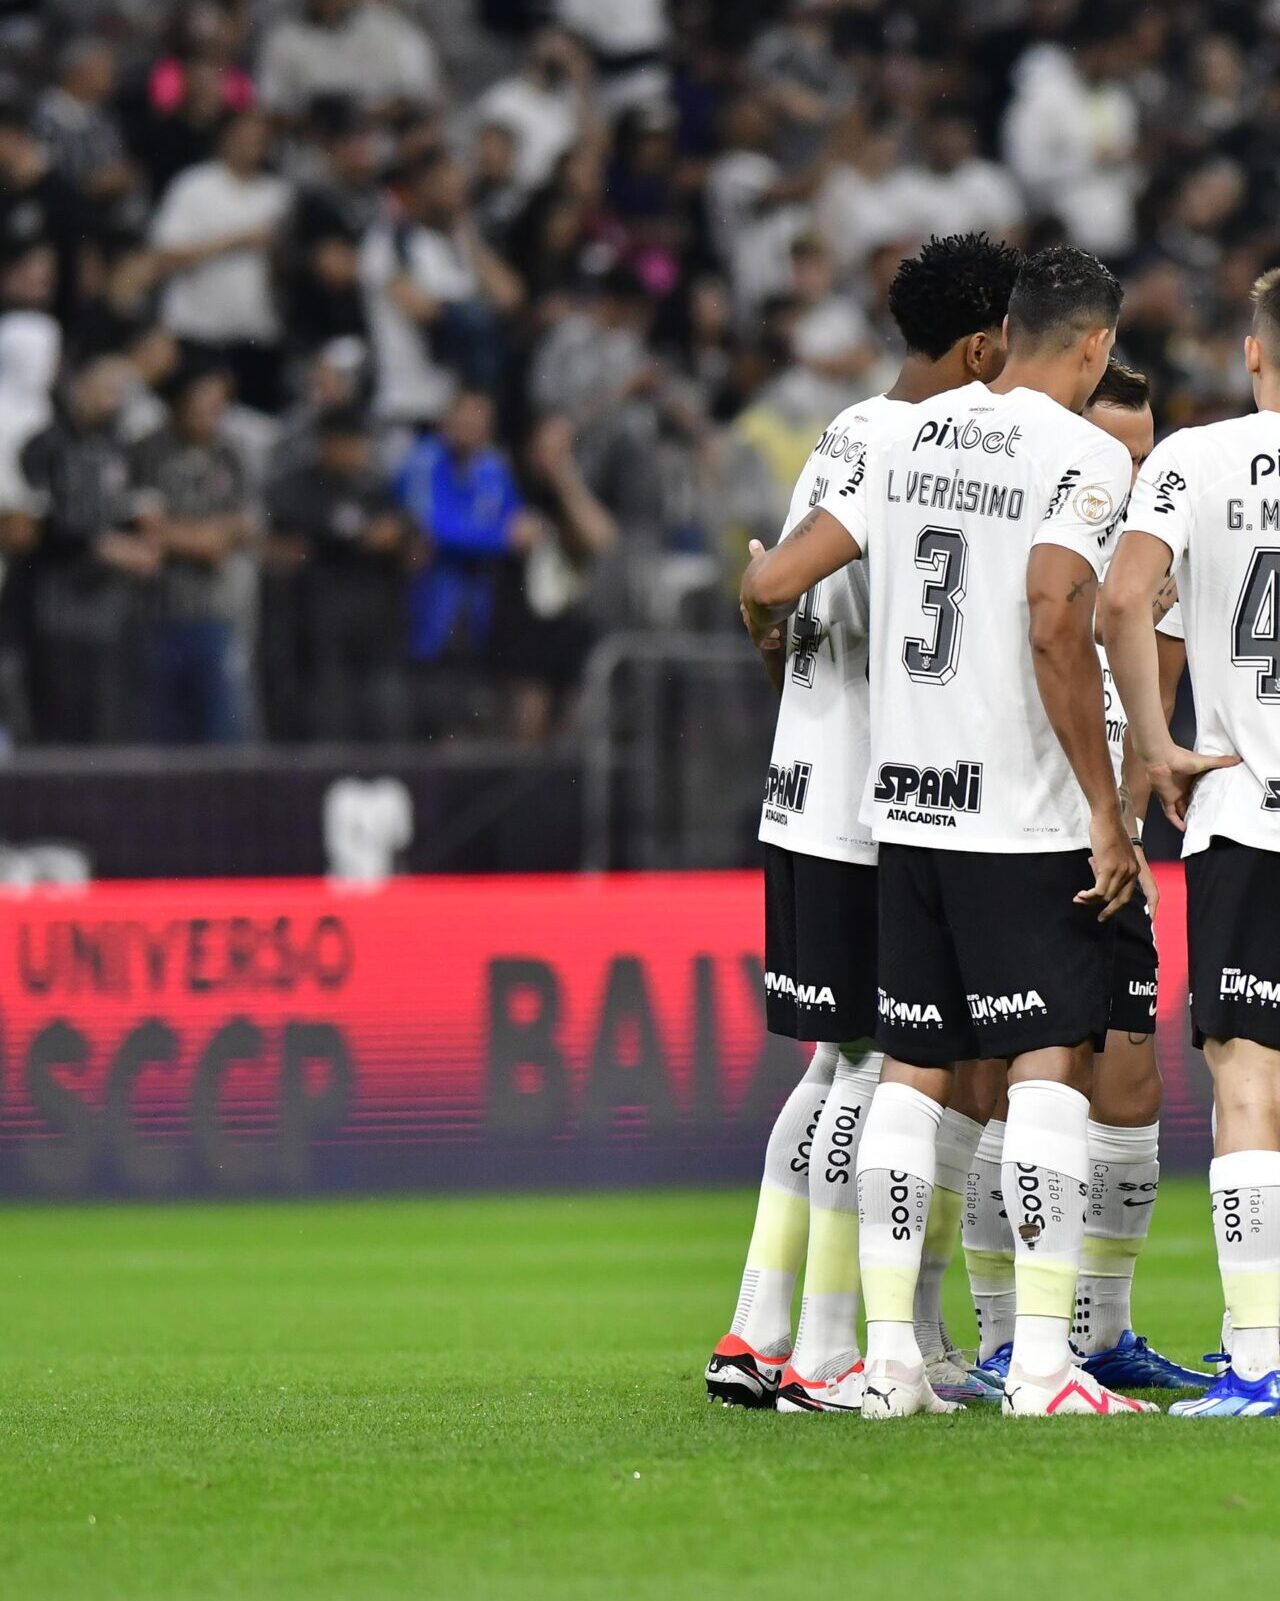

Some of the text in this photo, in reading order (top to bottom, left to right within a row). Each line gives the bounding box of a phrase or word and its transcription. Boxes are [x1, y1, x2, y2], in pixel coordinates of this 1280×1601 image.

[912, 417, 1022, 458] pixbet
[901, 524, 968, 686] 3
[887, 808, 957, 828] ATACADISTA
[18, 915, 355, 997] UNIVERSO
[878, 995, 943, 1022] UKMA
[486, 950, 800, 1135] BAIX
[24, 1013, 357, 1183] SCCP
[825, 1105, 861, 1184] TODOS
[890, 1170, 910, 1240] ODOS
[1048, 1171, 1064, 1200] rtão
[1223, 1189, 1242, 1242] DOS
[1250, 1189, 1264, 1213] rtão
